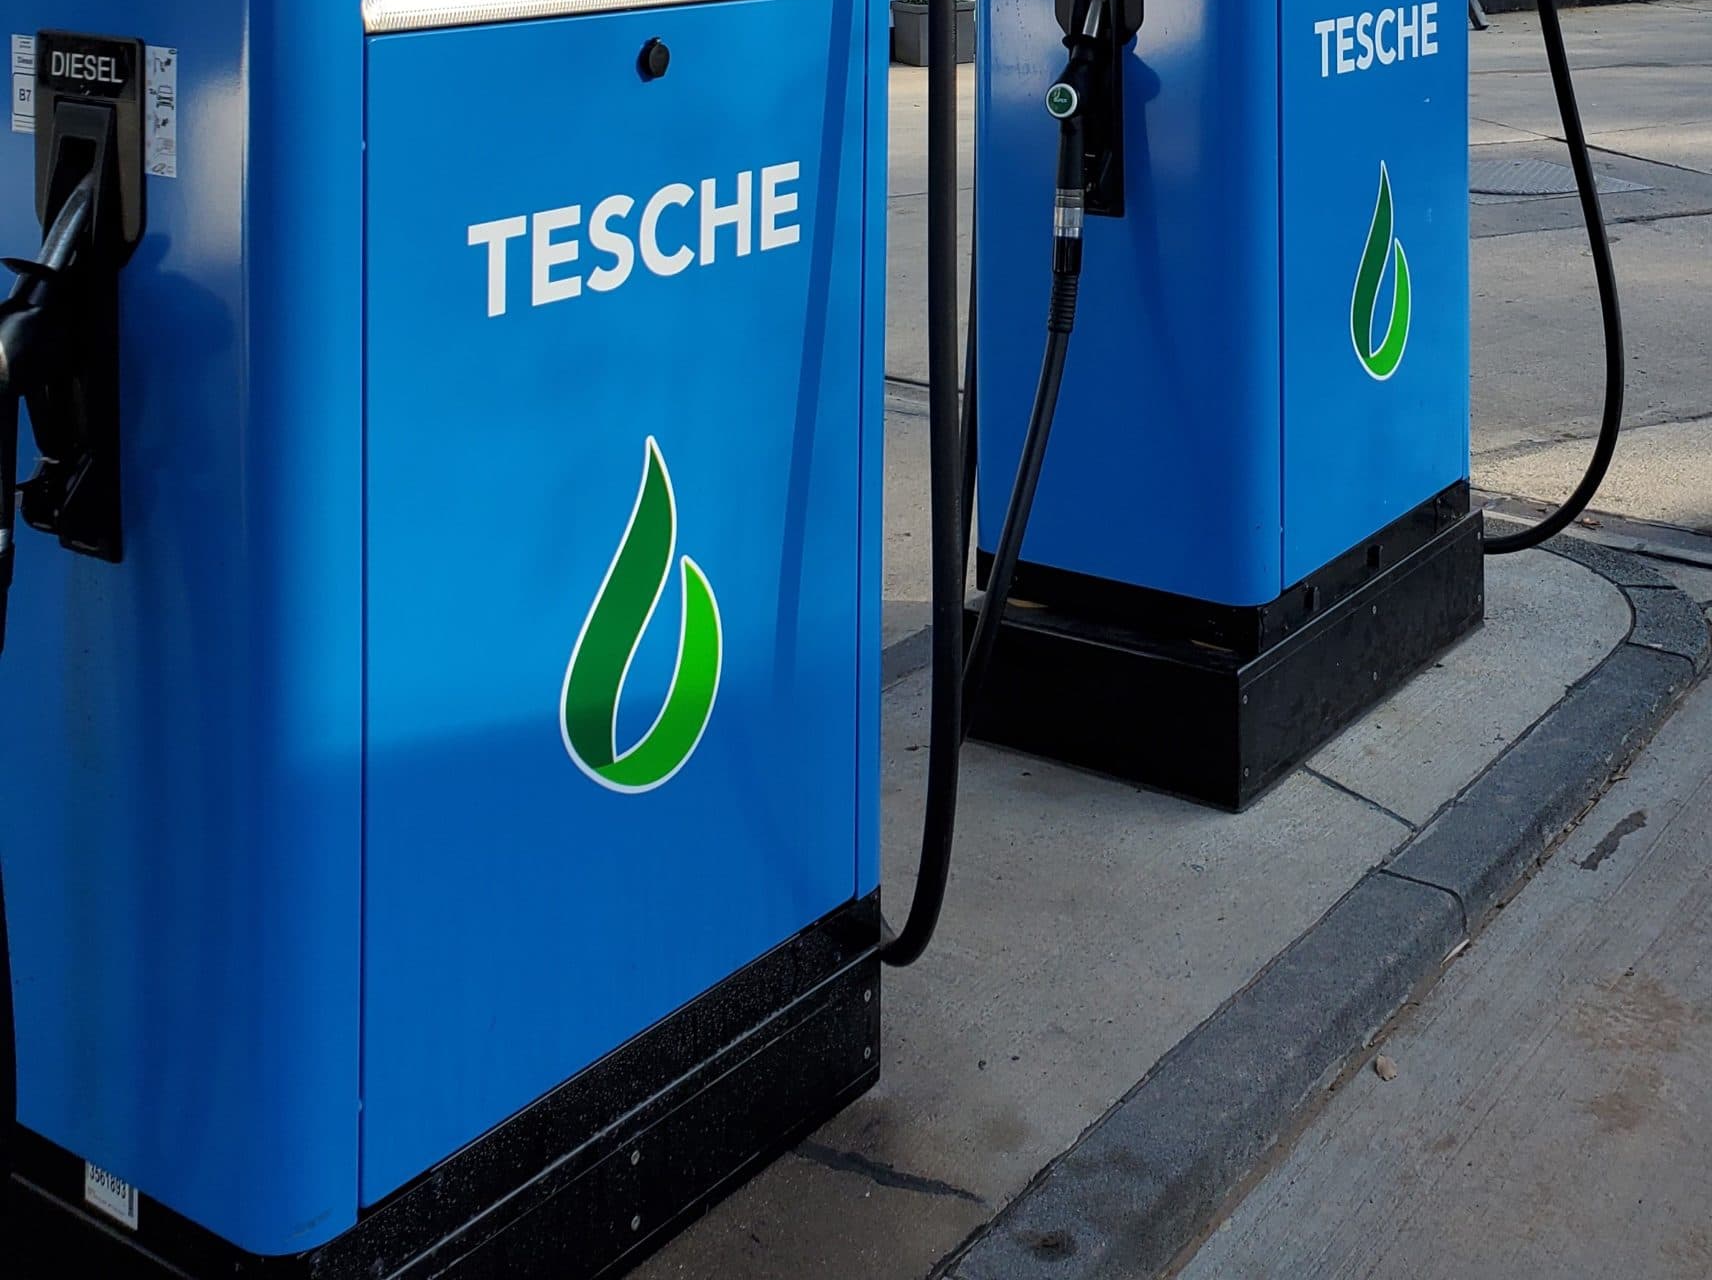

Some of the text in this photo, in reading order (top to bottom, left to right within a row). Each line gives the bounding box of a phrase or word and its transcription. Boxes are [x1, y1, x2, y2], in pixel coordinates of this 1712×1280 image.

[1314, 2, 1438, 78] TESCHE
[51, 51, 124, 84] DIESEL
[19, 88, 32, 102] B7
[468, 160, 800, 318] TESCHE
